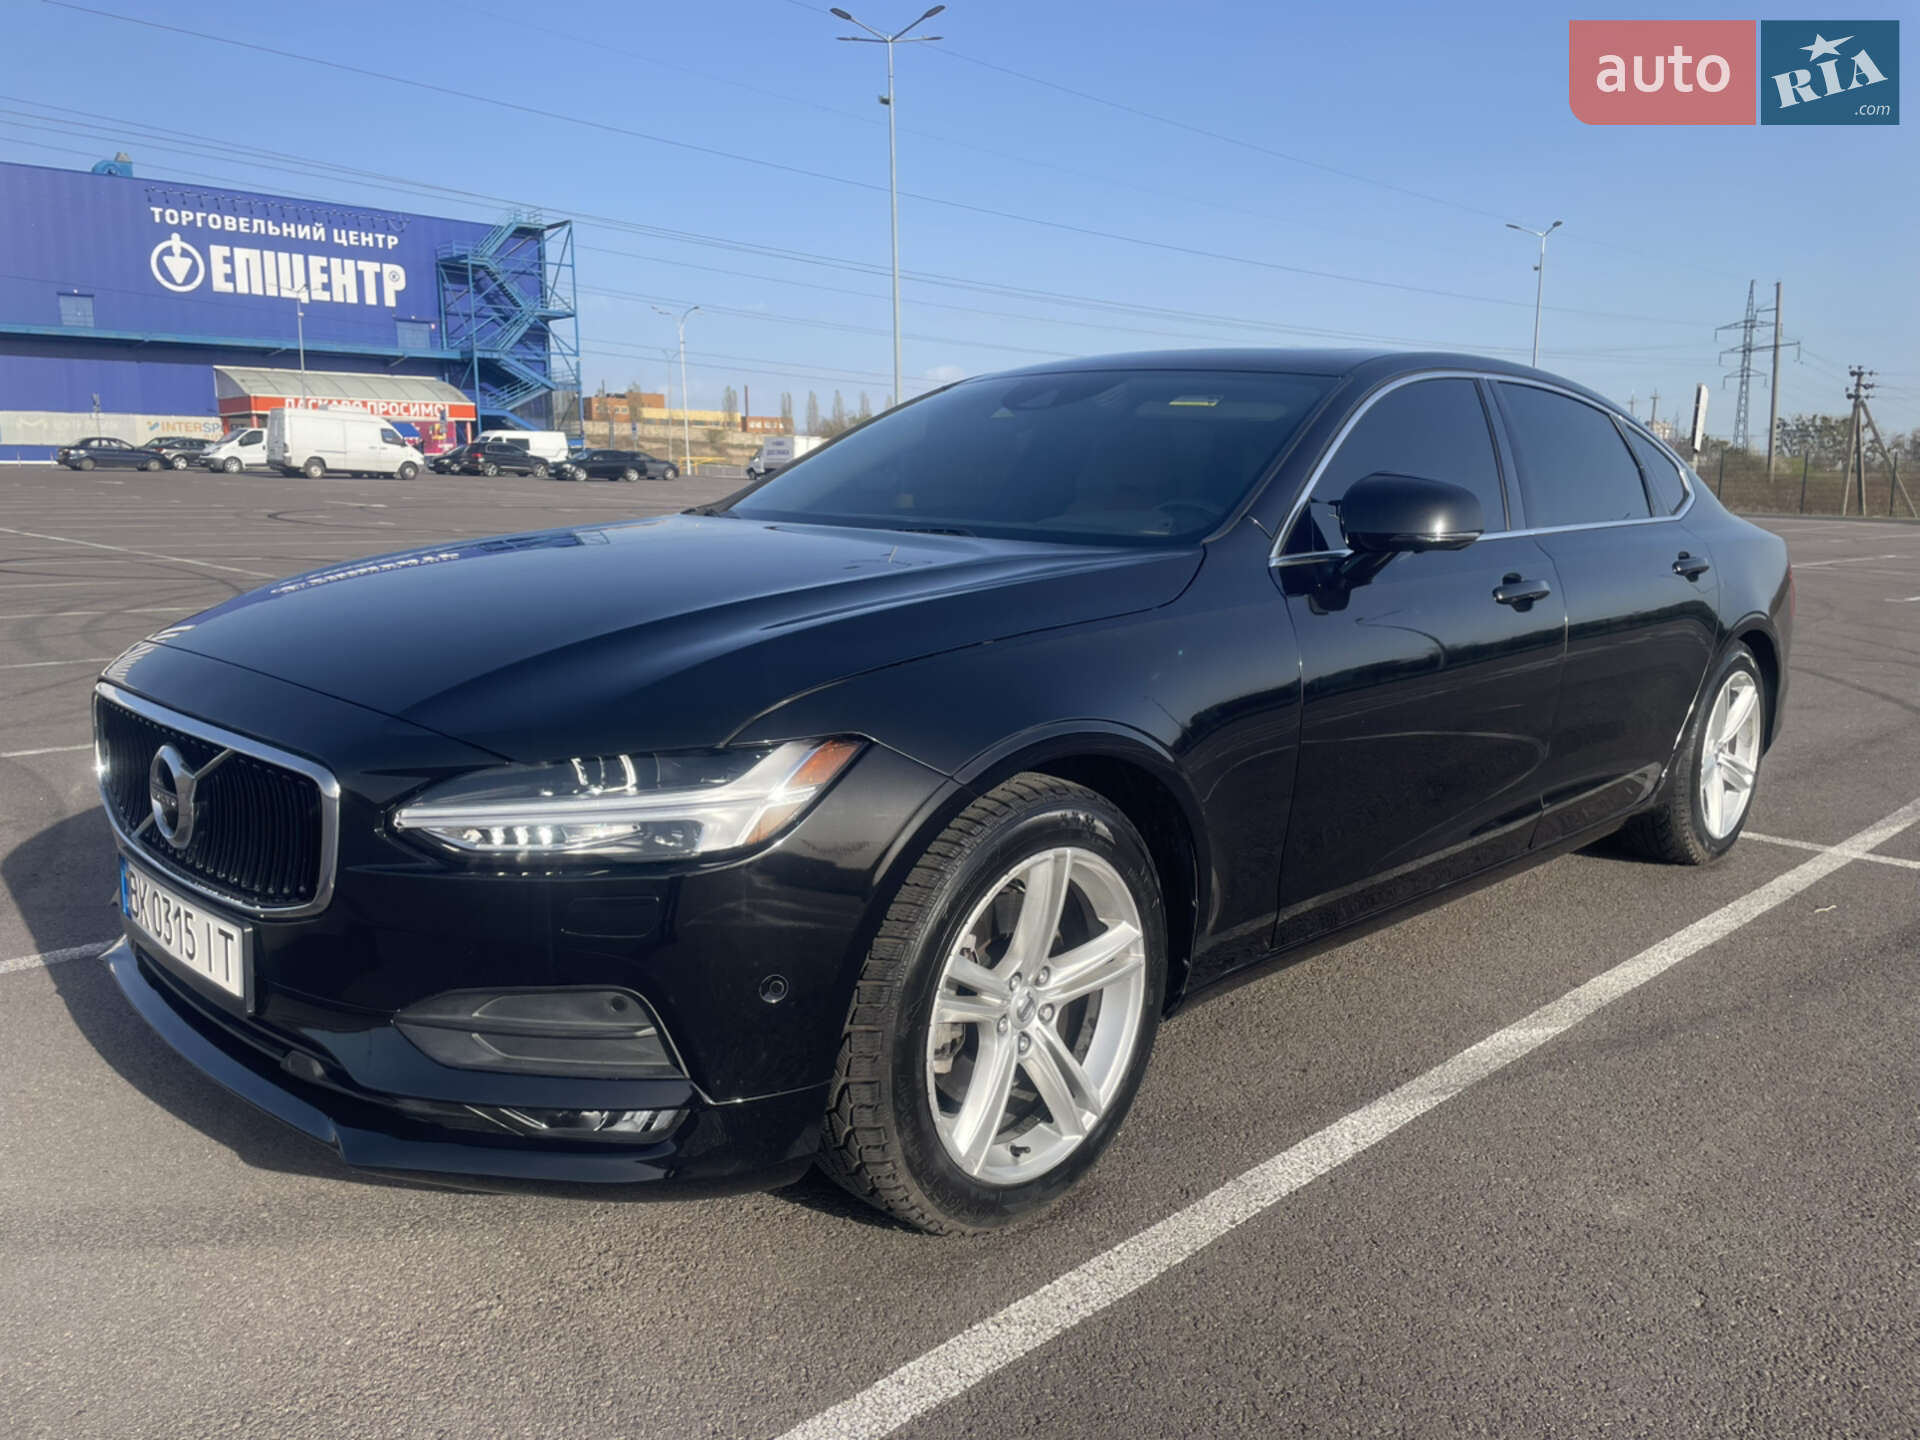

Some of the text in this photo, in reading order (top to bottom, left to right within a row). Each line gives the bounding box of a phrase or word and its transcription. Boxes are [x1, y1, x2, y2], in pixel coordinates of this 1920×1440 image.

[150, 206, 399, 250] ТОРГОВЕЛЬНИЙ ЦЕНТР
[209, 244, 407, 308] ЕПІЦЕНТР
[128, 870, 235, 983] BK 0315 IT
